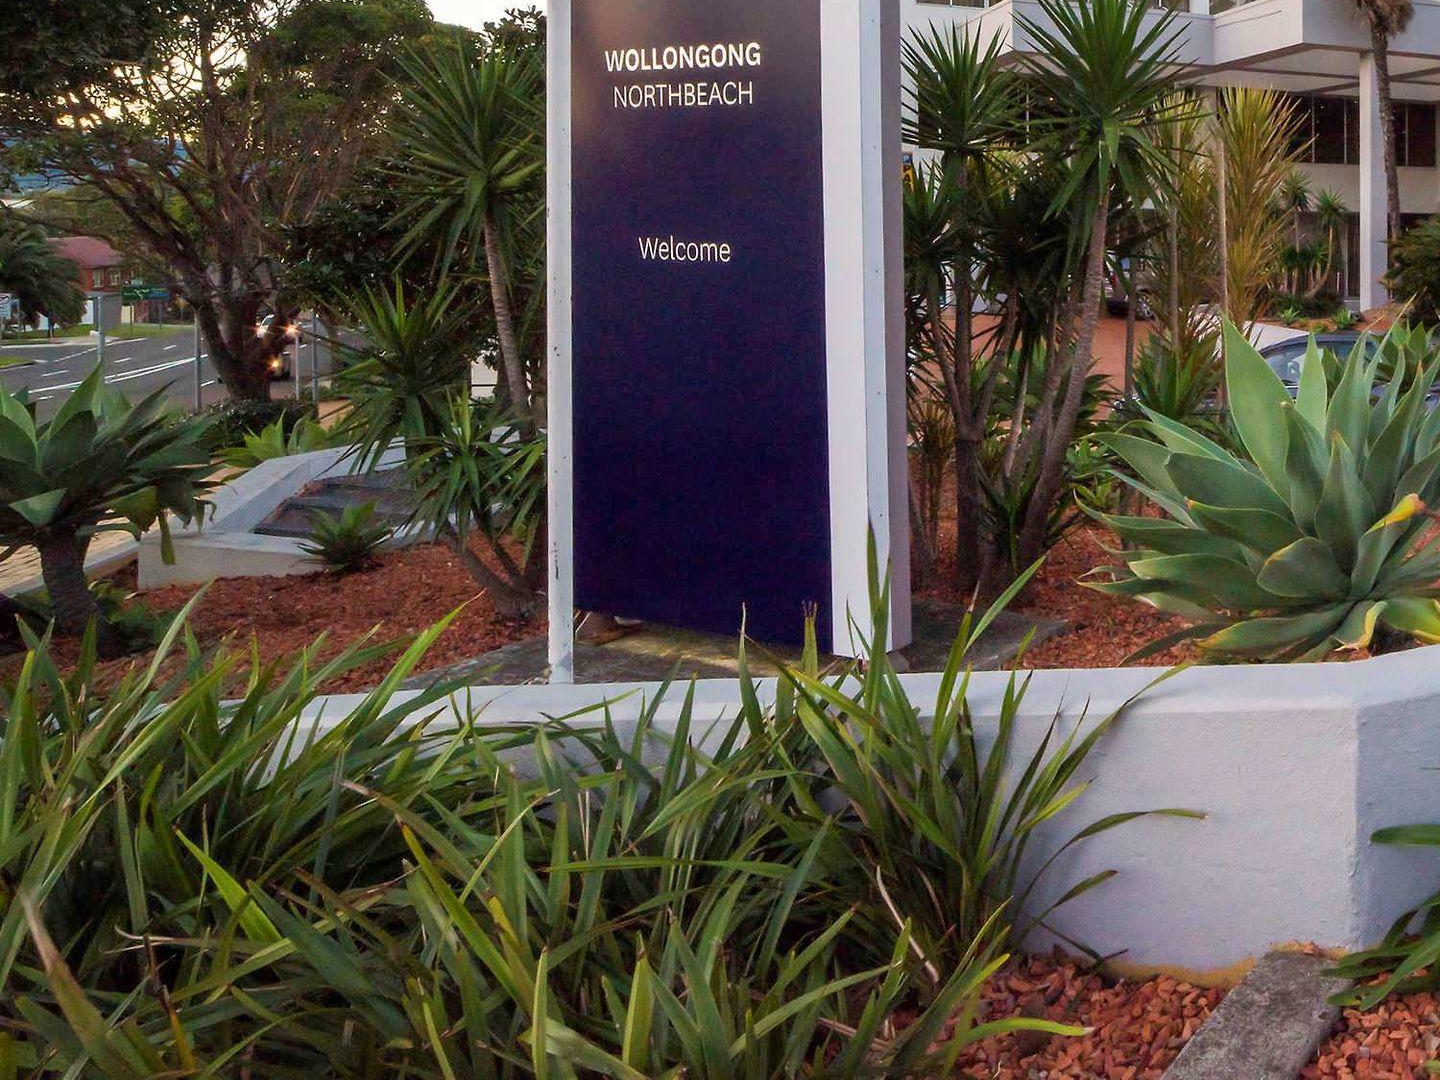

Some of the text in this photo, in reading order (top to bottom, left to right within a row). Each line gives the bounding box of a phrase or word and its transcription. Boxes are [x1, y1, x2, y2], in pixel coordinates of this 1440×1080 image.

[605, 42, 761, 72] WOLLONGONG
[614, 81, 753, 108] NORTHBEACH
[638, 235, 731, 263] Welcome
